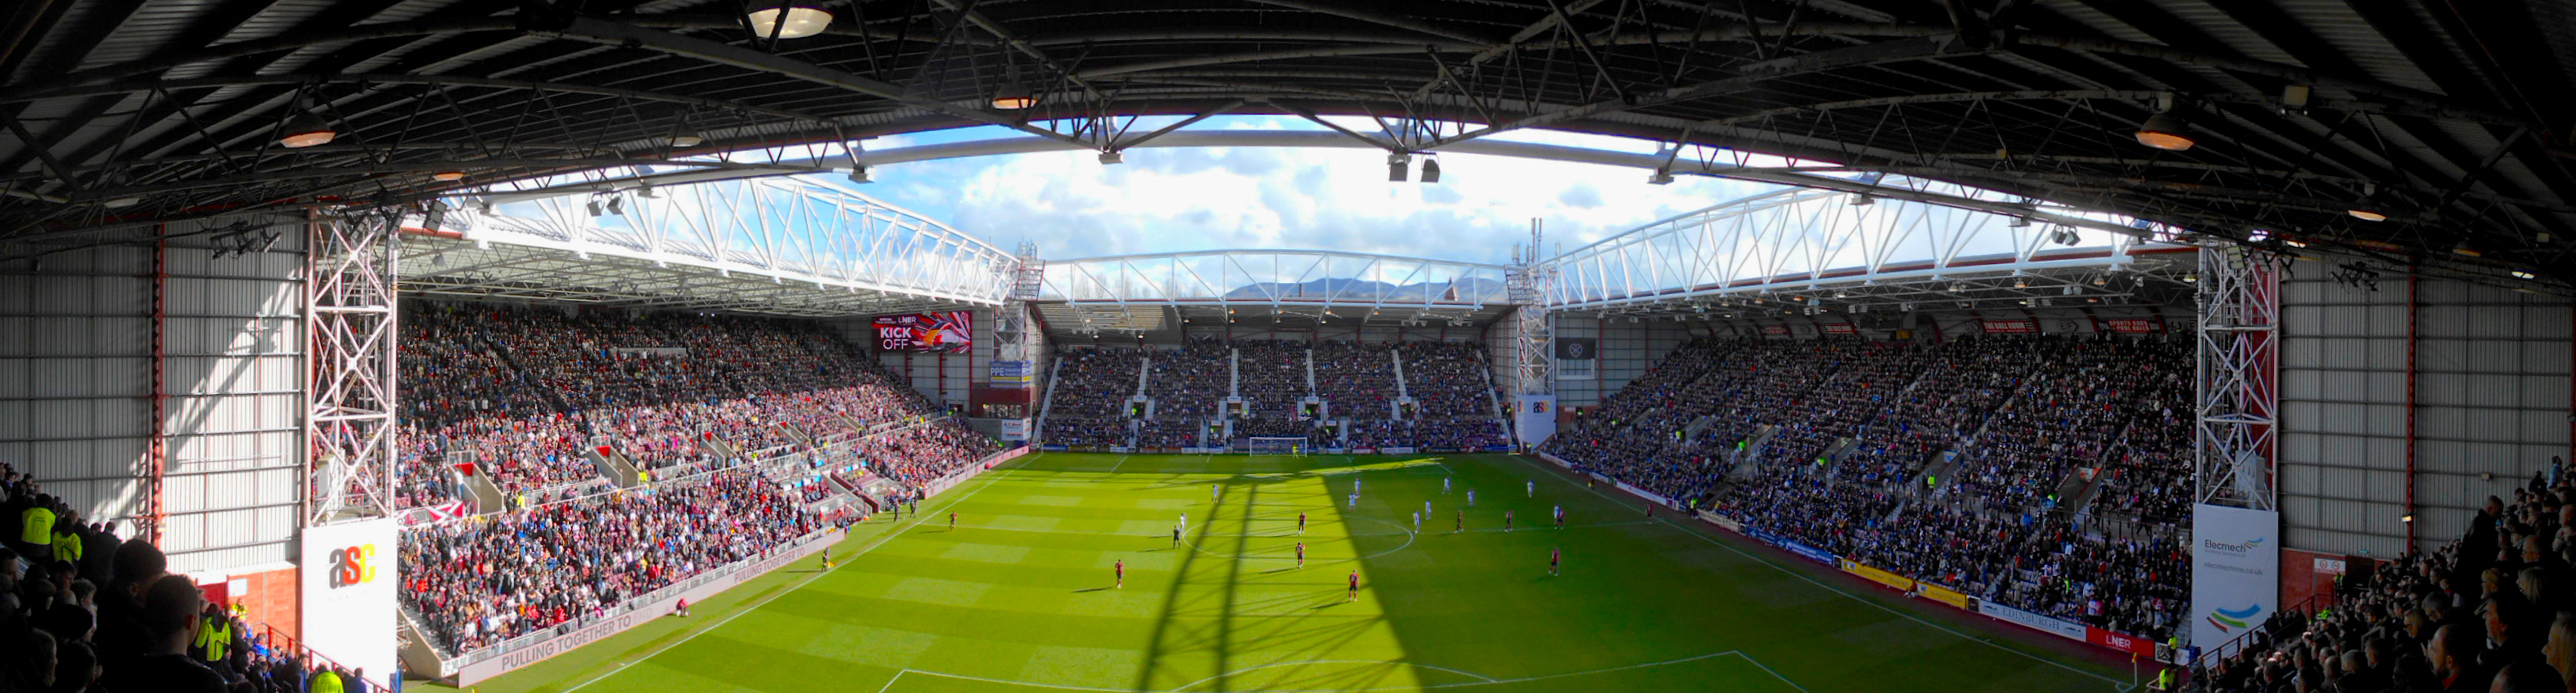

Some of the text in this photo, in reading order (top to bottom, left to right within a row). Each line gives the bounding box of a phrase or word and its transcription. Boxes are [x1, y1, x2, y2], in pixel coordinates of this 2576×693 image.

[880, 327, 912, 338] KICK
[883, 339, 909, 350] OFF
[991, 367, 1005, 376] PPE
[2205, 539, 2246, 553] Elecmech
[330, 544, 375, 589] asc
[734, 548, 806, 583] PULLING TOGETHER TO
[2002, 607, 2060, 630] EDINBURGH
[502, 642, 555, 671] PULLING
[556, 621, 615, 651] TOGETHER
[616, 615, 632, 629] TO
[2106, 634, 2131, 649] LNER
